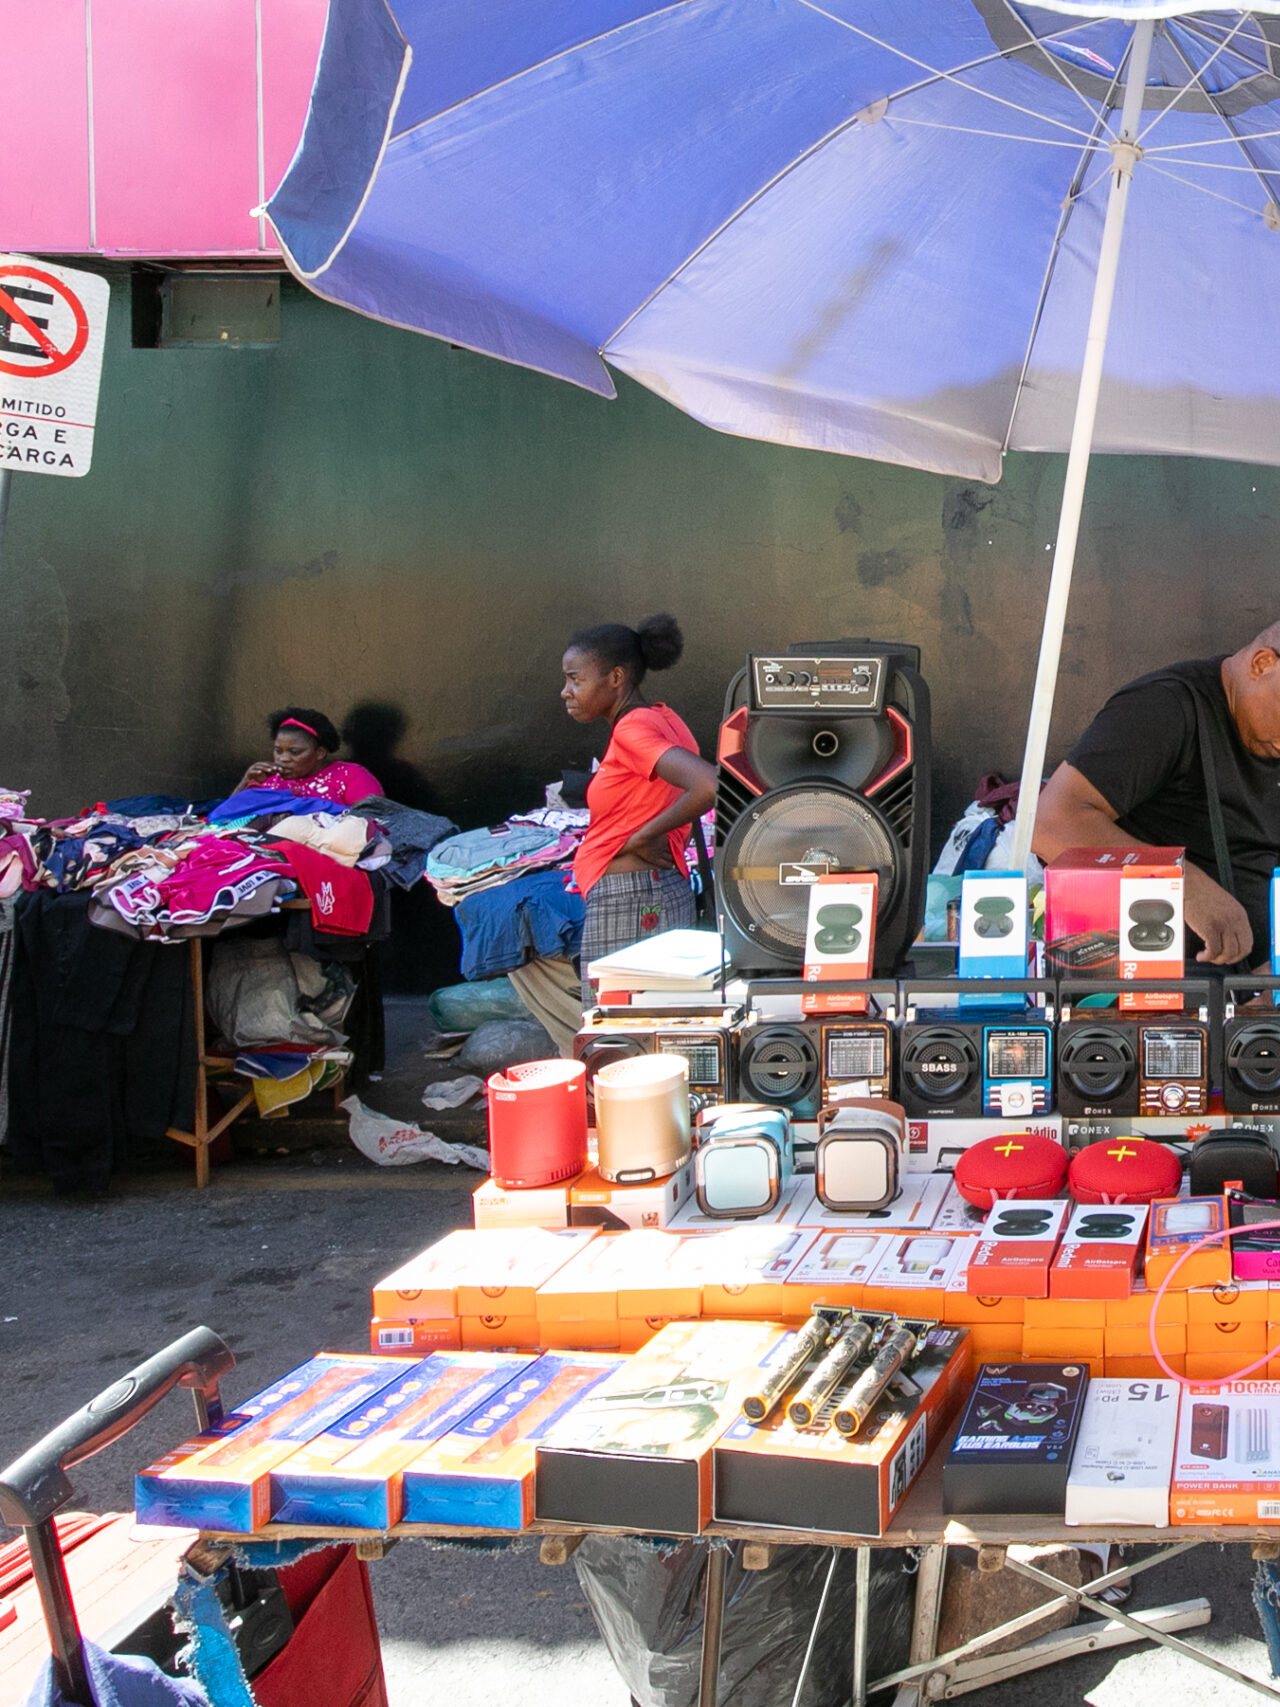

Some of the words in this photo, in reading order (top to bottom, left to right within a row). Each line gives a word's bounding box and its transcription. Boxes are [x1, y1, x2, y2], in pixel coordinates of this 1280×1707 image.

[54, 429, 67, 444] E
[921, 1063, 957, 1072] SBASS
[973, 1241, 999, 1266] Redmi
[1056, 1244, 1081, 1268] Redmi
[1127, 1383, 1170, 1402] 15
